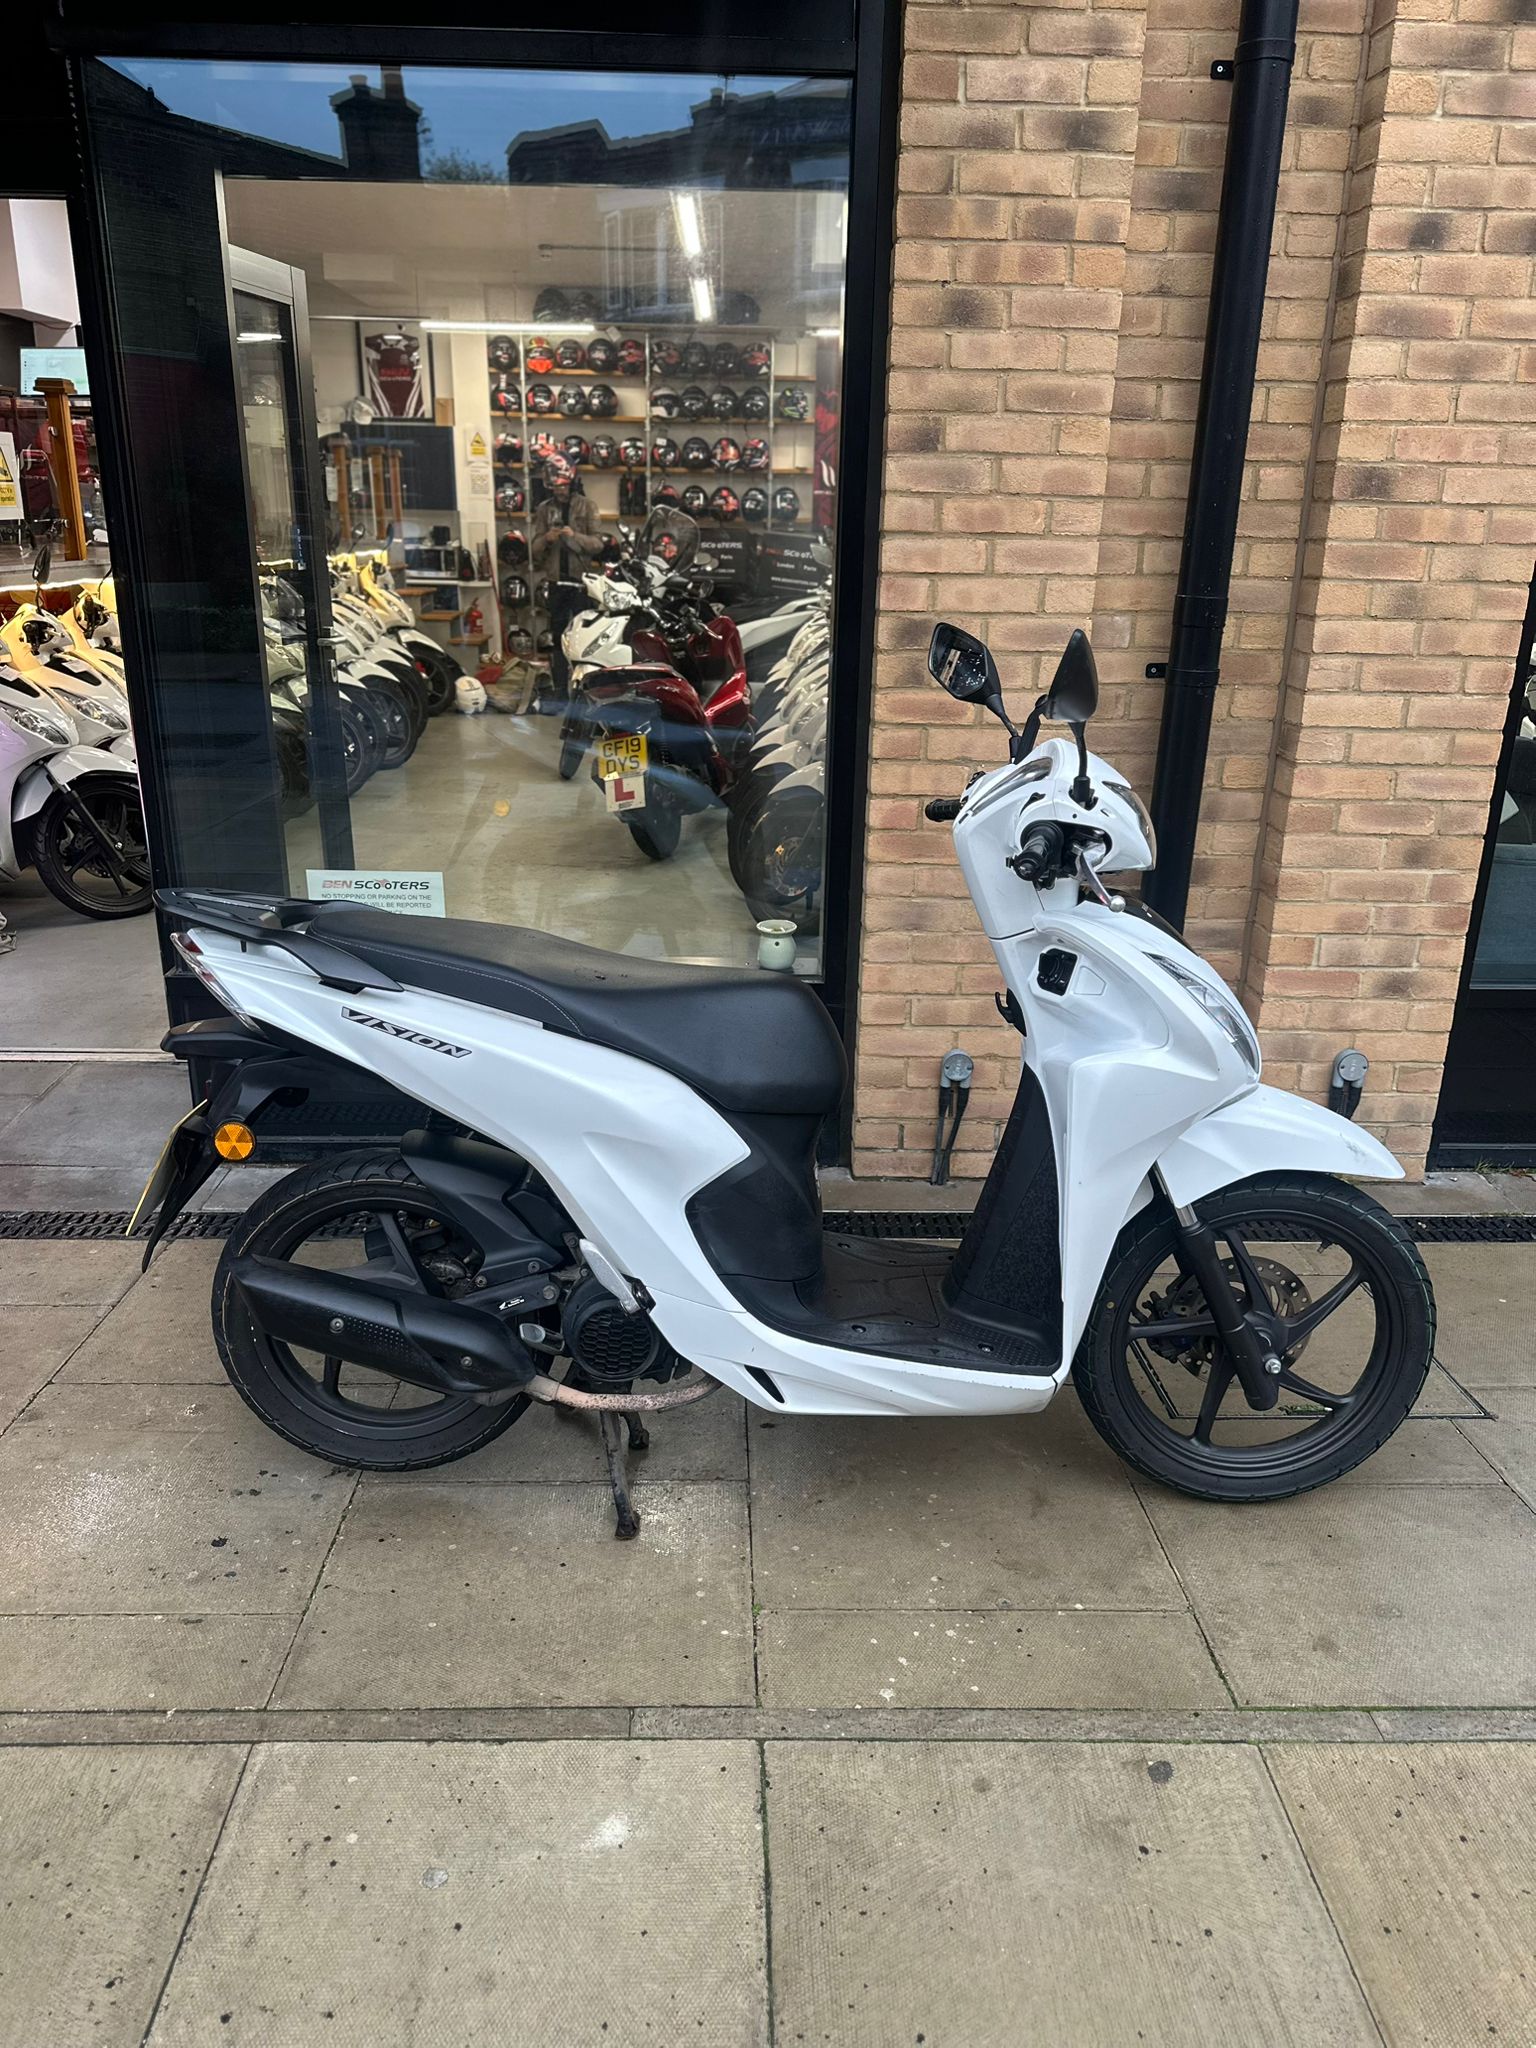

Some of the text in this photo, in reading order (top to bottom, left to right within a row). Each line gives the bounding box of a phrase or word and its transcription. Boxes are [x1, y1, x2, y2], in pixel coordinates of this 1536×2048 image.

[614, 778, 636, 803] L
[322, 880, 352, 889] BEN
[341, 1006, 472, 1058] VISION
